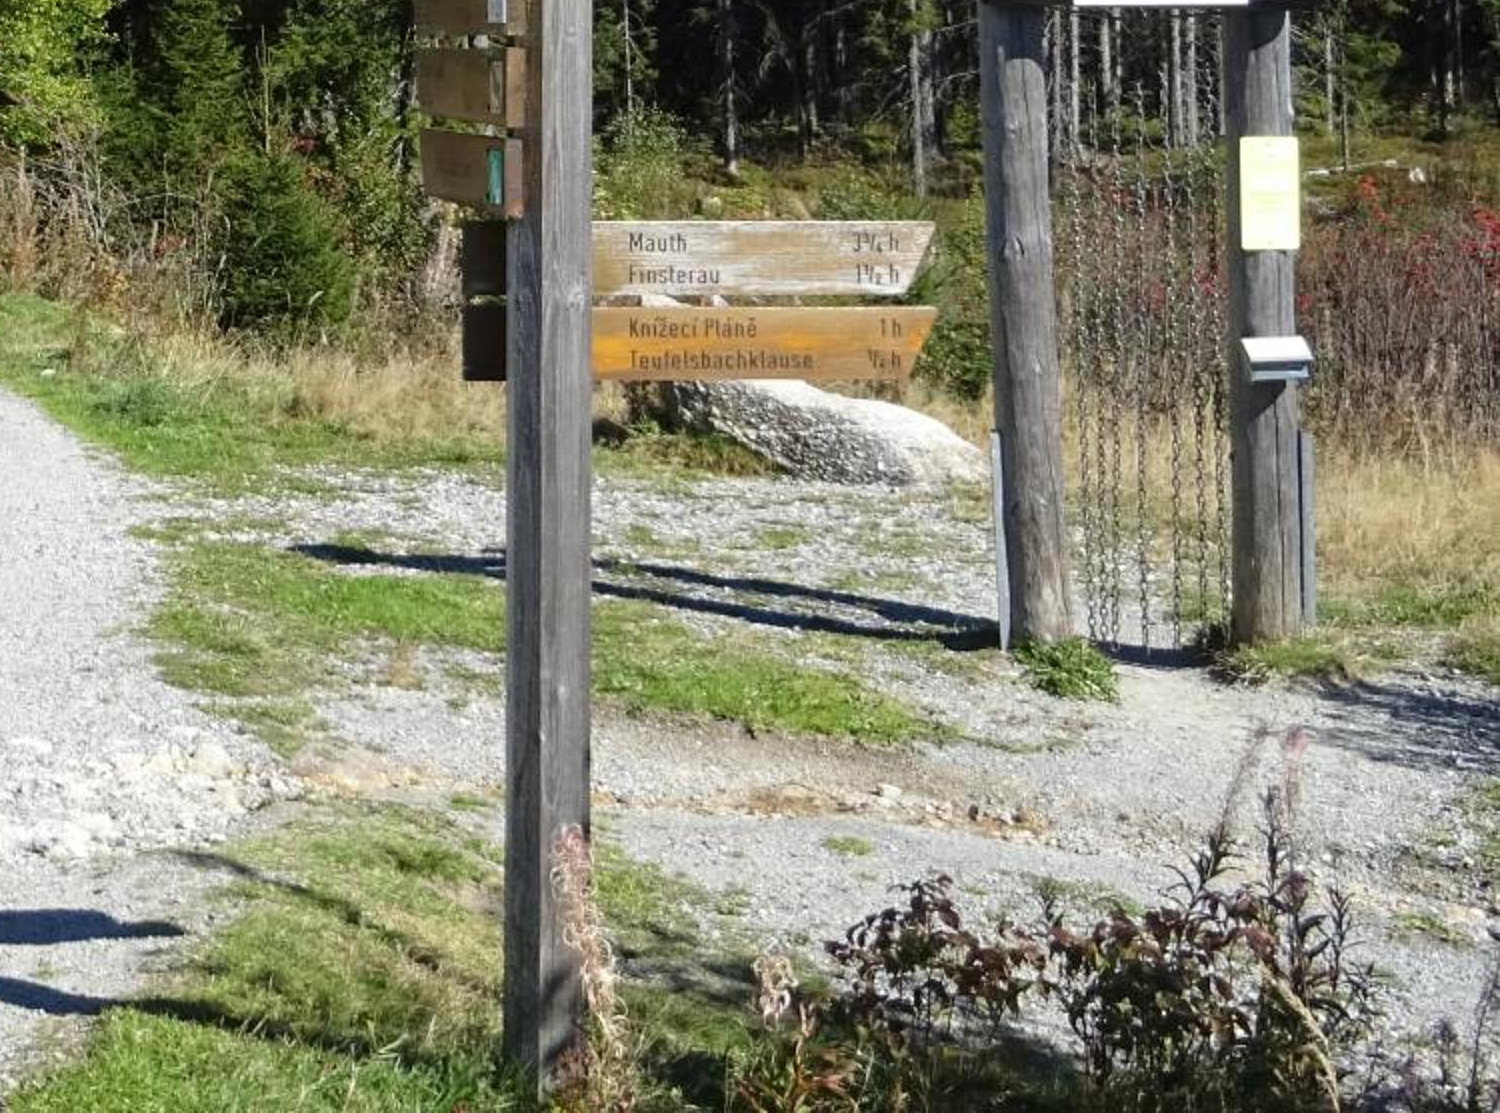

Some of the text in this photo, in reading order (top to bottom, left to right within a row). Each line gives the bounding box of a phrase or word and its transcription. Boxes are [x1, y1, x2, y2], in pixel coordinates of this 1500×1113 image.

[628, 231, 688, 253] Mauth
[888, 230, 900, 253] h
[628, 264, 721, 284] Finsterau
[888, 262, 900, 284] h
[881, 317, 887, 337] 1
[891, 317, 902, 337] h
[628, 350, 815, 371] Teufelsbachklause
[891, 348, 902, 369] h
